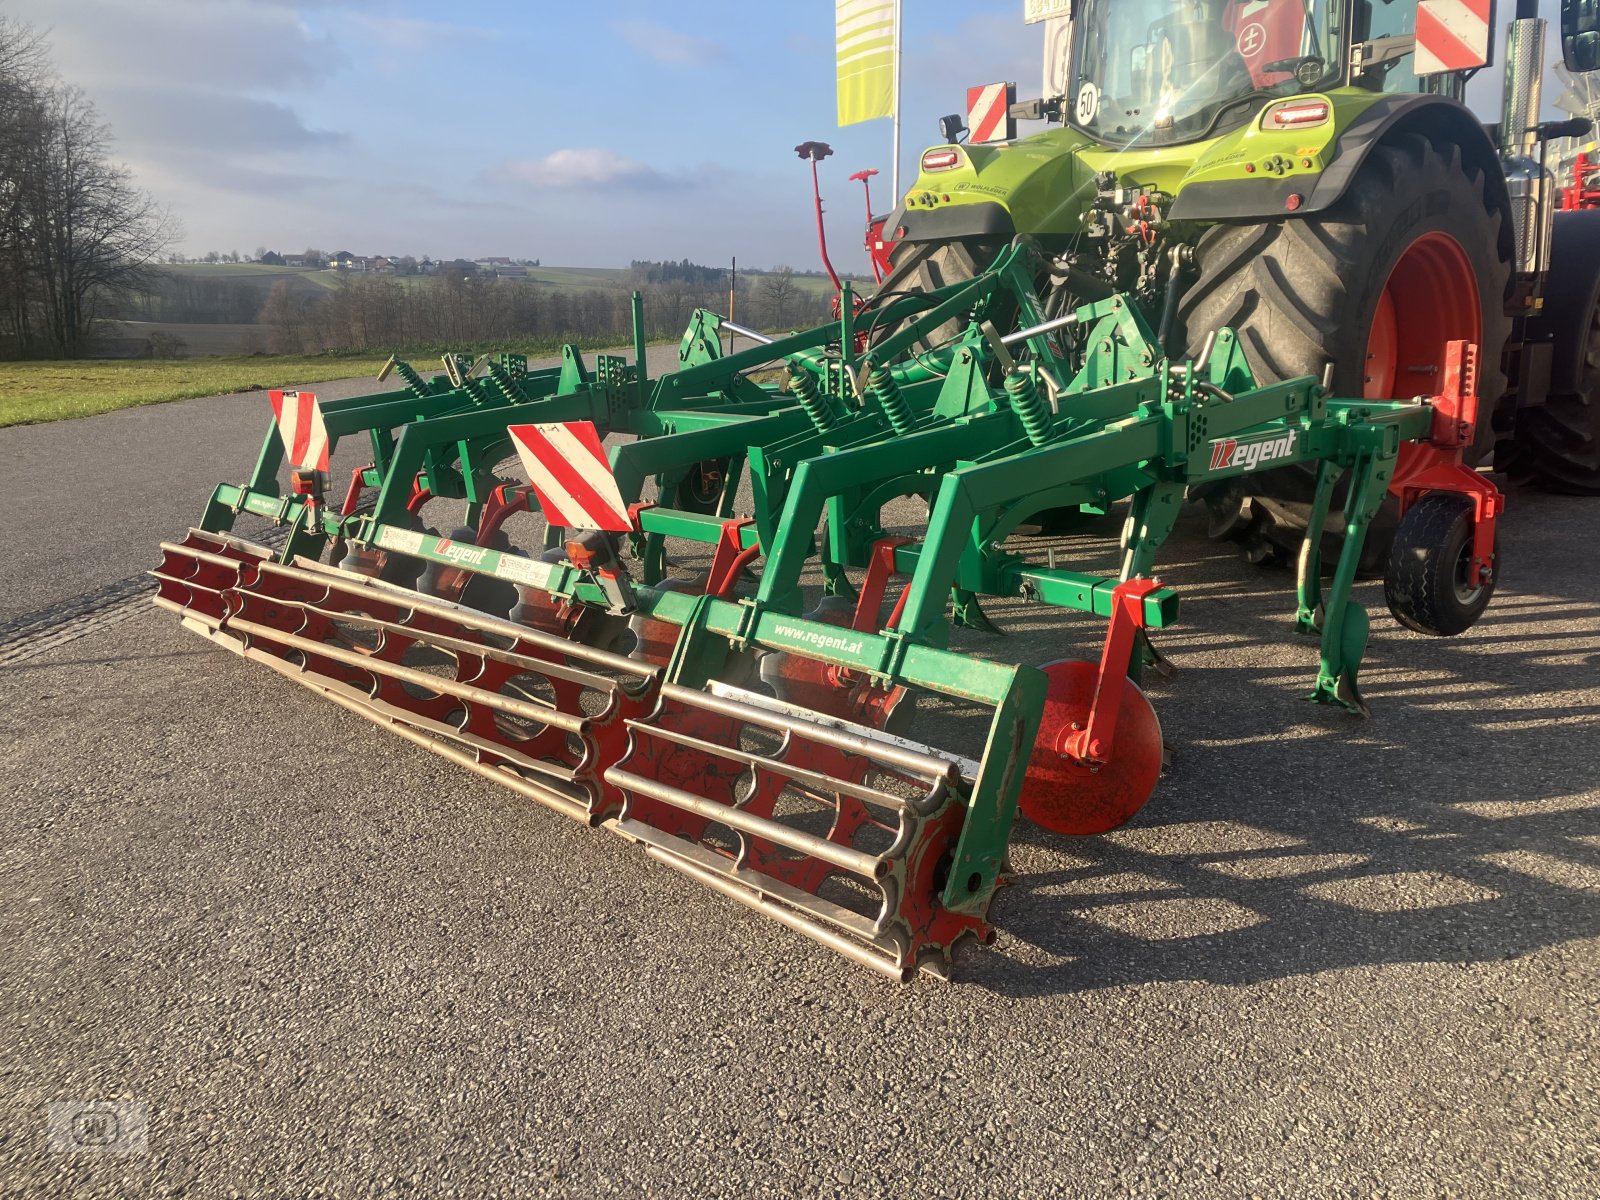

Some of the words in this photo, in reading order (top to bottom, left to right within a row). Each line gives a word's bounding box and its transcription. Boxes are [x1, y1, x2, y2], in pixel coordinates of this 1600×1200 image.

[1080, 91, 1094, 118] 50
[1209, 428, 1297, 471] Regent
[434, 537, 489, 565] Regent
[774, 624, 863, 655] www.regent.at
